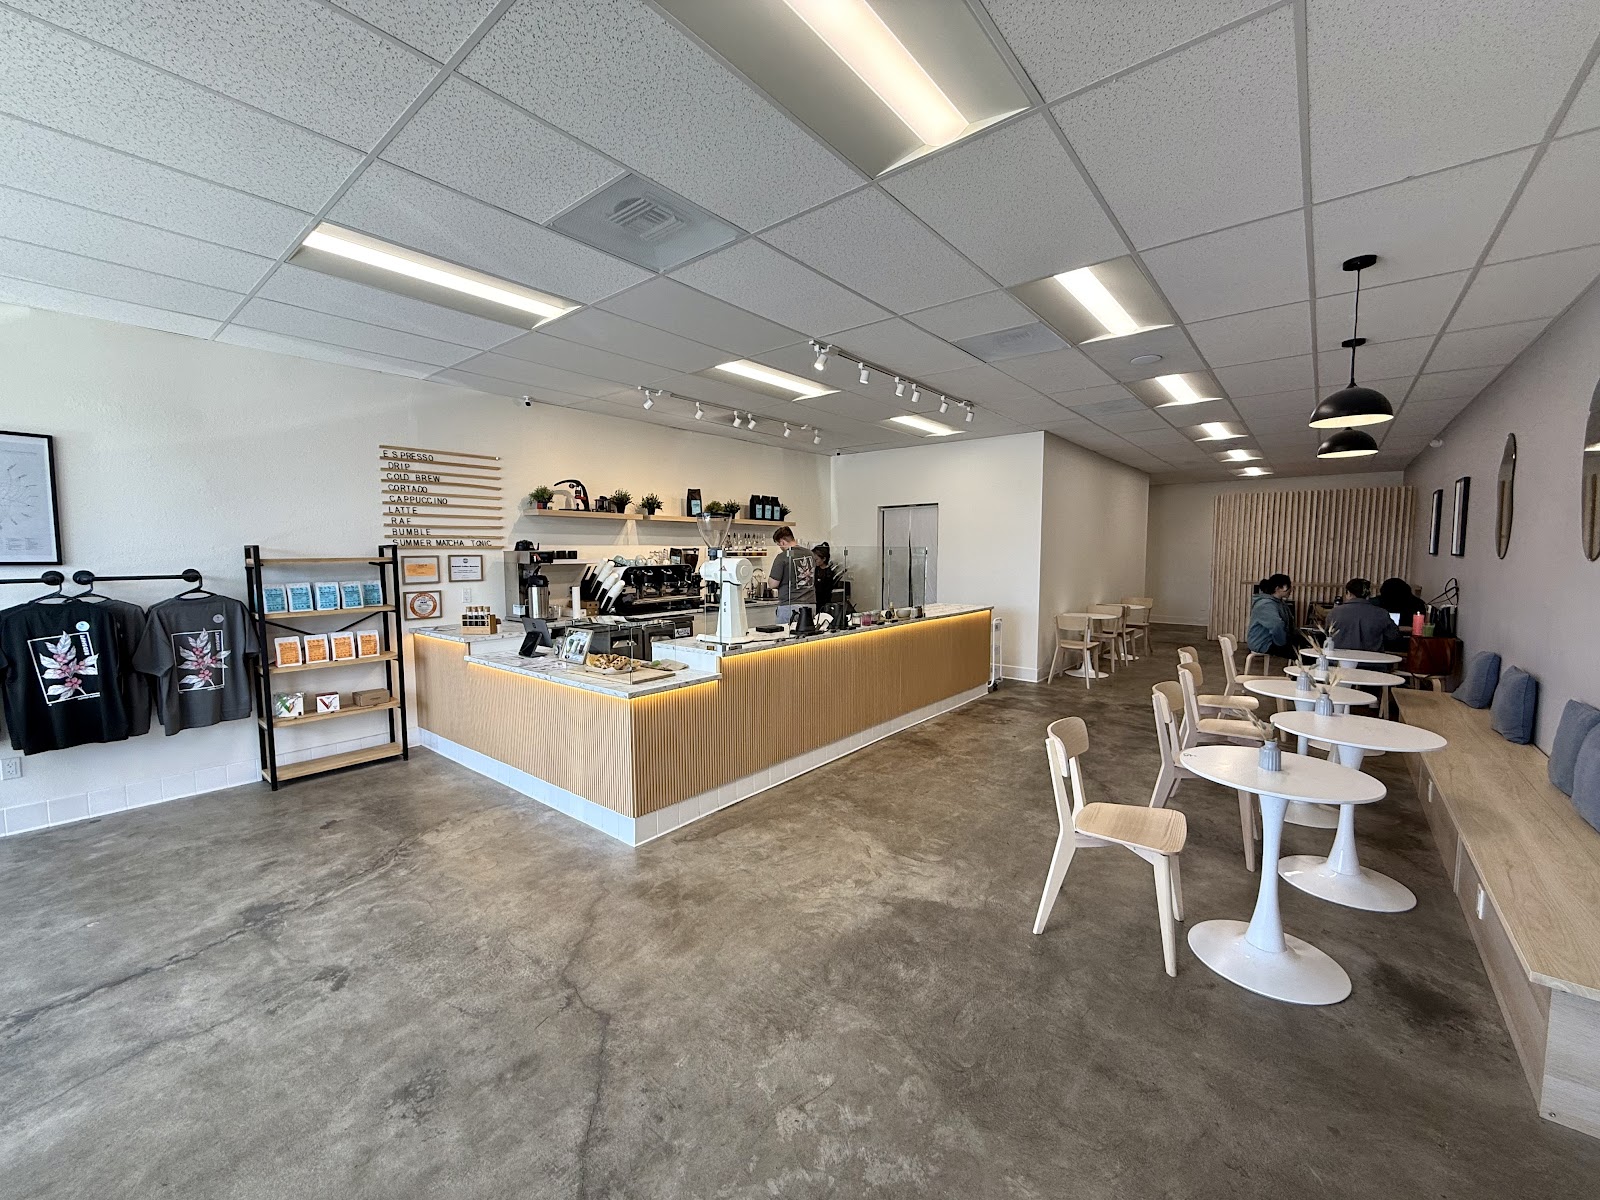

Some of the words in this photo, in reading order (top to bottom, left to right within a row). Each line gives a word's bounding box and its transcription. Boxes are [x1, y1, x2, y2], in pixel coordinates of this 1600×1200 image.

[383, 450, 434, 461] ESPRESSO
[388, 462, 410, 470] DRIP
[387, 473, 409, 481] COLD
[415, 474, 440, 482] BREW
[388, 484, 428, 493] CORTADO
[389, 495, 448, 504] CAPPUCCINO
[388, 506, 418, 514] LATTE
[391, 517, 411, 525] RAF
[392, 528, 431, 536] BUMBLE
[392, 539, 432, 547] SUMMER
[435, 539, 465, 547] MATCHA
